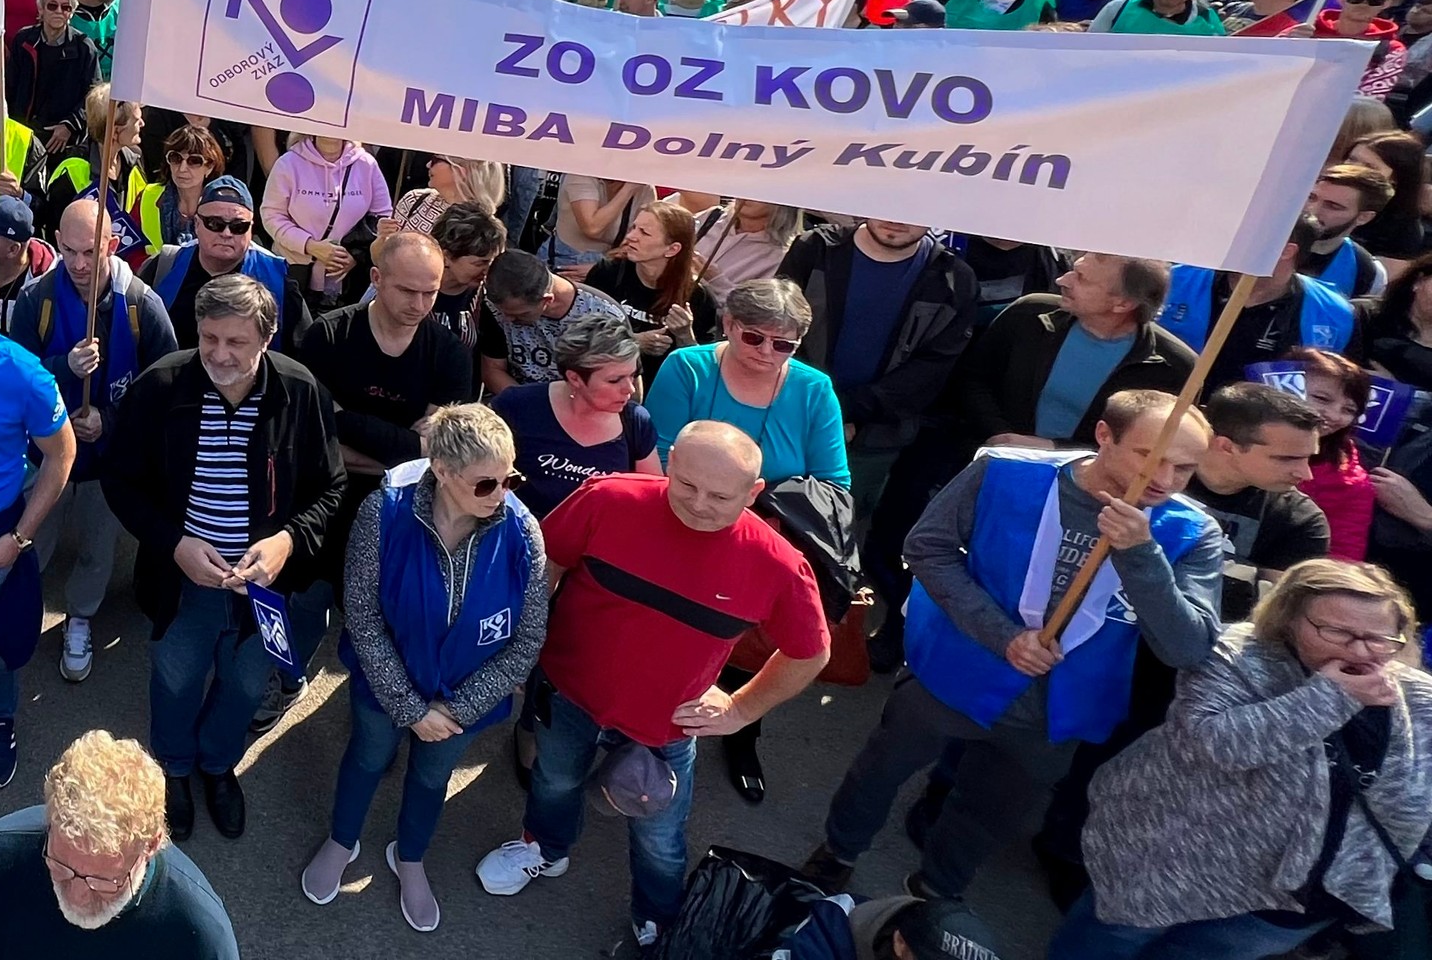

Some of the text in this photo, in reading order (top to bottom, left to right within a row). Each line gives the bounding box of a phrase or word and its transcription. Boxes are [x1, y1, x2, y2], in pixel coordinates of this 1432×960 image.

[209, 41, 275, 88] ODBOROVÝ
[494, 32, 993, 124] ZO OZ KOVO
[402, 86, 1072, 191] MIBA Dolný Kubín
